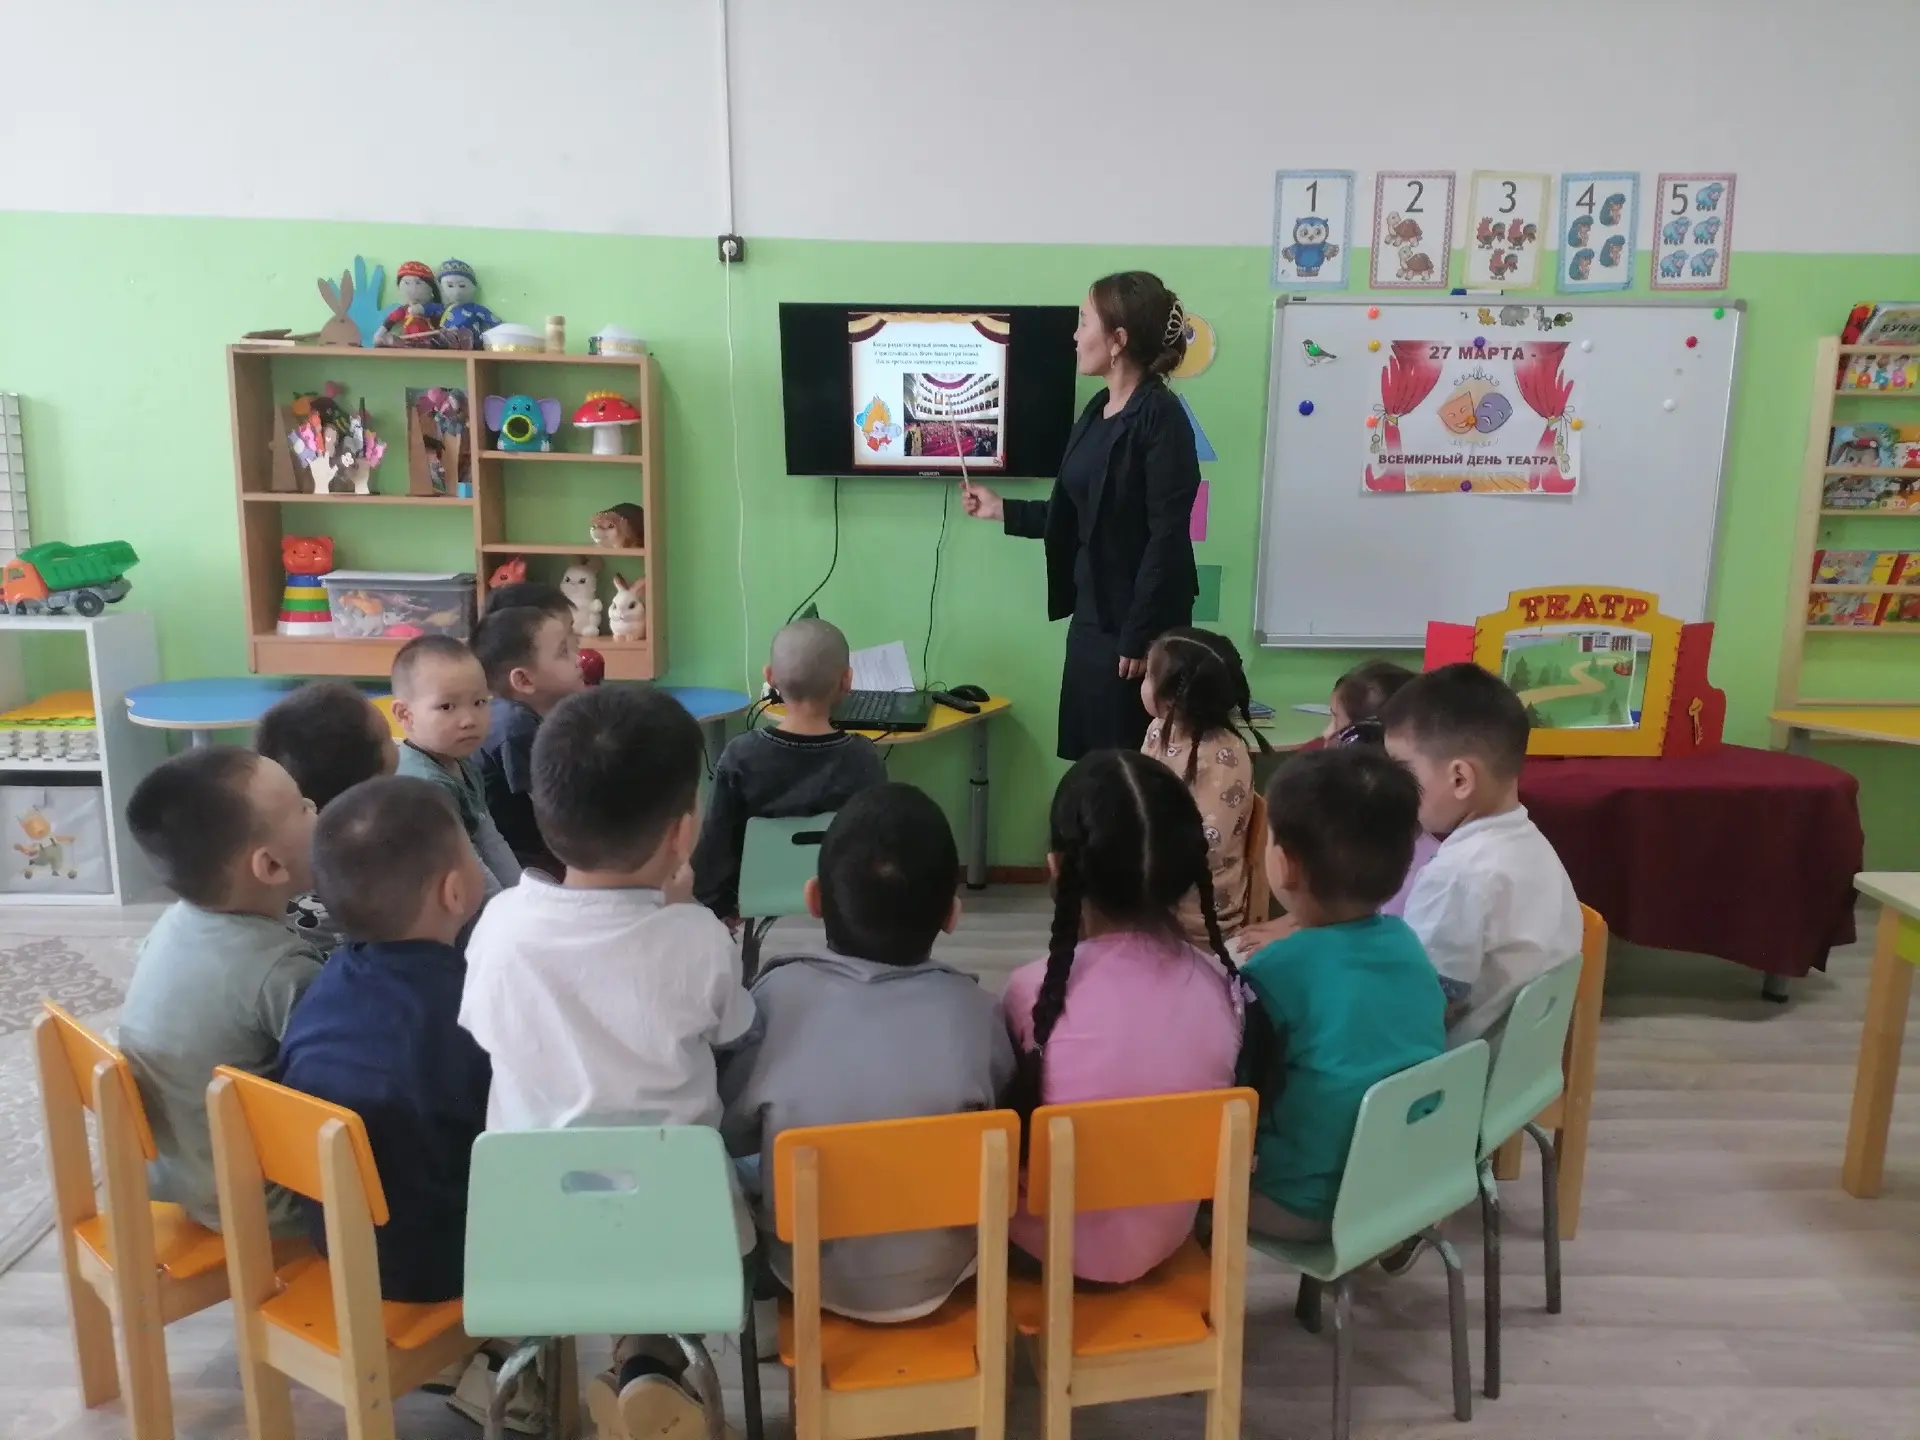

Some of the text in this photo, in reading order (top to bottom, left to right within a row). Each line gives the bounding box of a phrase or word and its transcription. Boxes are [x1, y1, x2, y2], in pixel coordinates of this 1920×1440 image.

[1305, 180, 1319, 212] 1
[1405, 180, 1424, 213] 2
[1498, 180, 1517, 214] 3
[1575, 182, 1596, 215] 4
[1670, 183, 1688, 215] 5
[1429, 346, 1451, 360] 27
[1458, 346, 1525, 361] МАРТА
[1378, 453, 1557, 467] ВСЕМИРНЫЙ ДЕНЬ ТЕАТРА
[1519, 593, 1649, 622] ТЕАТР
